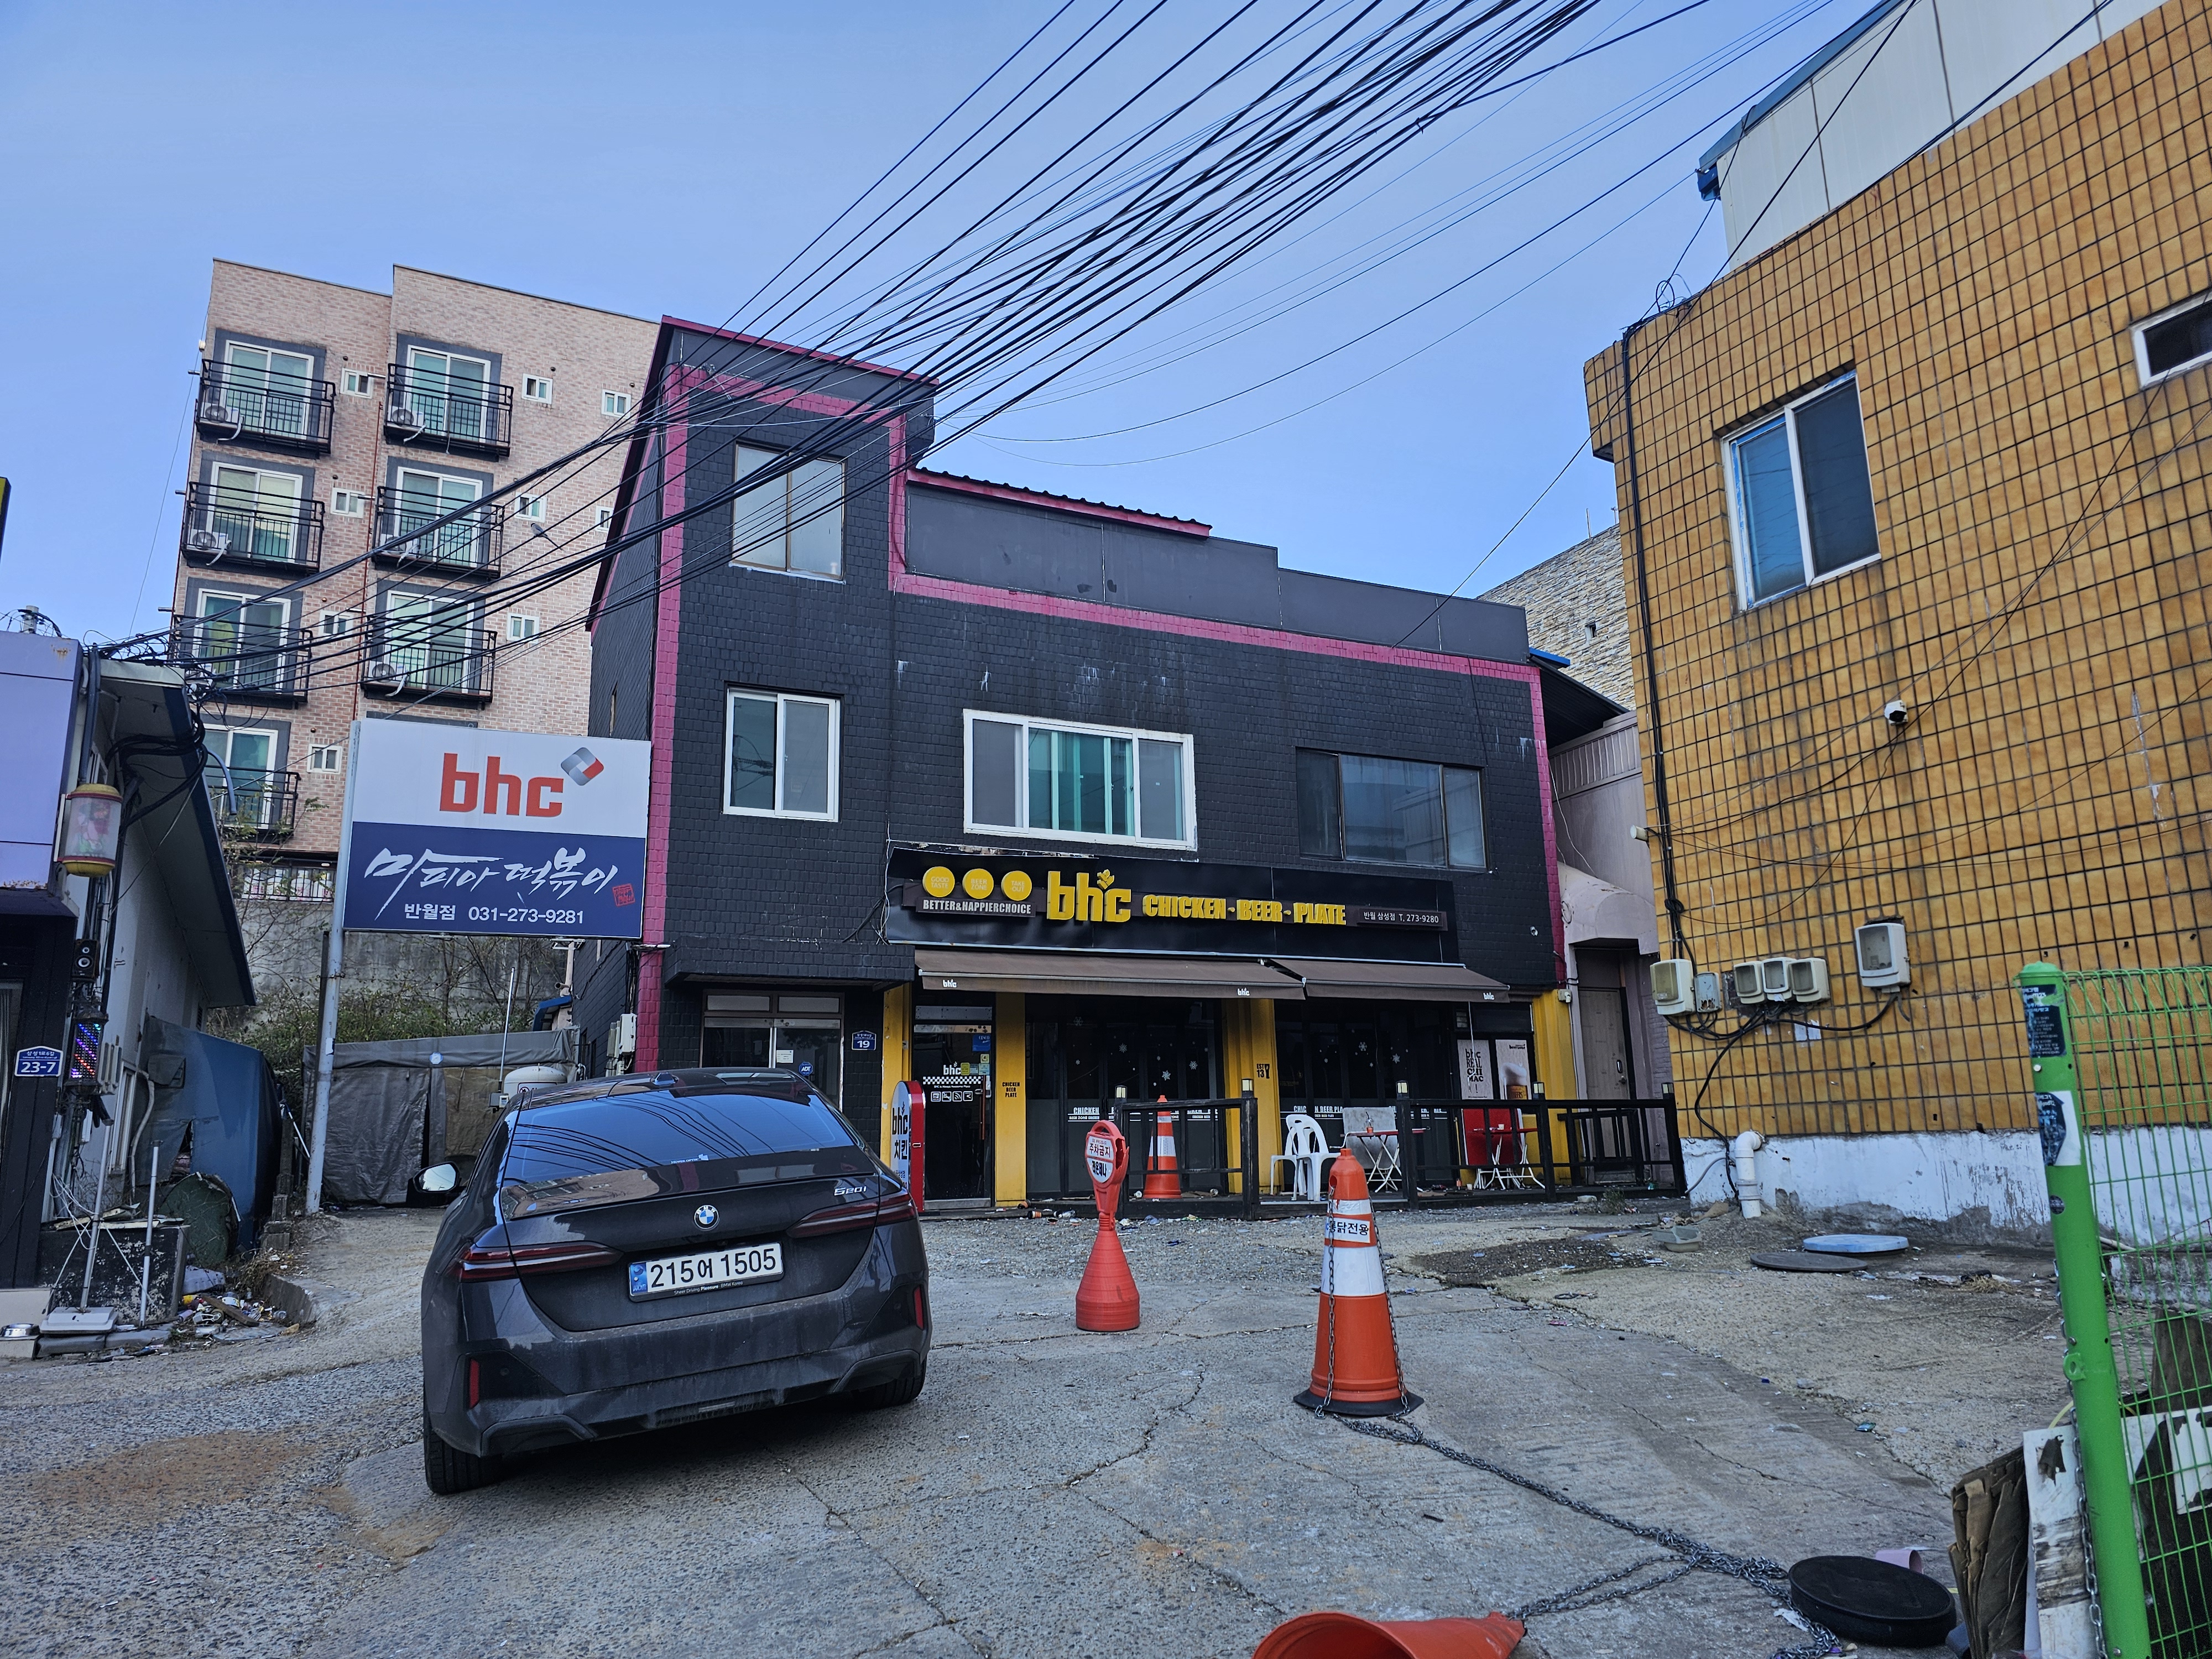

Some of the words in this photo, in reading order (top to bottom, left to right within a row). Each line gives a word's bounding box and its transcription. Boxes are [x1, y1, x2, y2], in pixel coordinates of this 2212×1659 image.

[440, 753, 564, 817] bhc
[364, 848, 504, 921] 마피아
[504, 847, 619, 900] 떡볶이
[1047, 870, 1131, 922] bhc
[404, 903, 456, 921] 반월점
[468, 906, 584, 924] 031-273-9281
[1142, 894, 1227, 919] CHICKEN
[1237, 899, 1283, 922] BEER
[1293, 902, 1347, 925] PLATE
[1364, 912, 1376, 920] 반월
[1378, 912, 1395, 921] 삼성점
[1407, 914, 1439, 923] 273-9280
[942, 979, 957, 988] bhc
[1237, 987, 1250, 996] bhc
[1483, 992, 1495, 1000] bhc
[857, 1040, 870, 1048] 19
[1465, 1048, 1481, 1058] bhc
[21, 1062, 56, 1073] 23-7
[943, 1063, 961, 1075] bhc
[1467, 1058, 1483, 1068] REAL
[892, 1107, 908, 1135] bhc
[894, 1140, 907, 1160] 치킨
[1089, 1143, 1110, 1158] 주차금지
[650, 1258, 713, 1288] 215어
[721, 1248, 776, 1276] 1505
